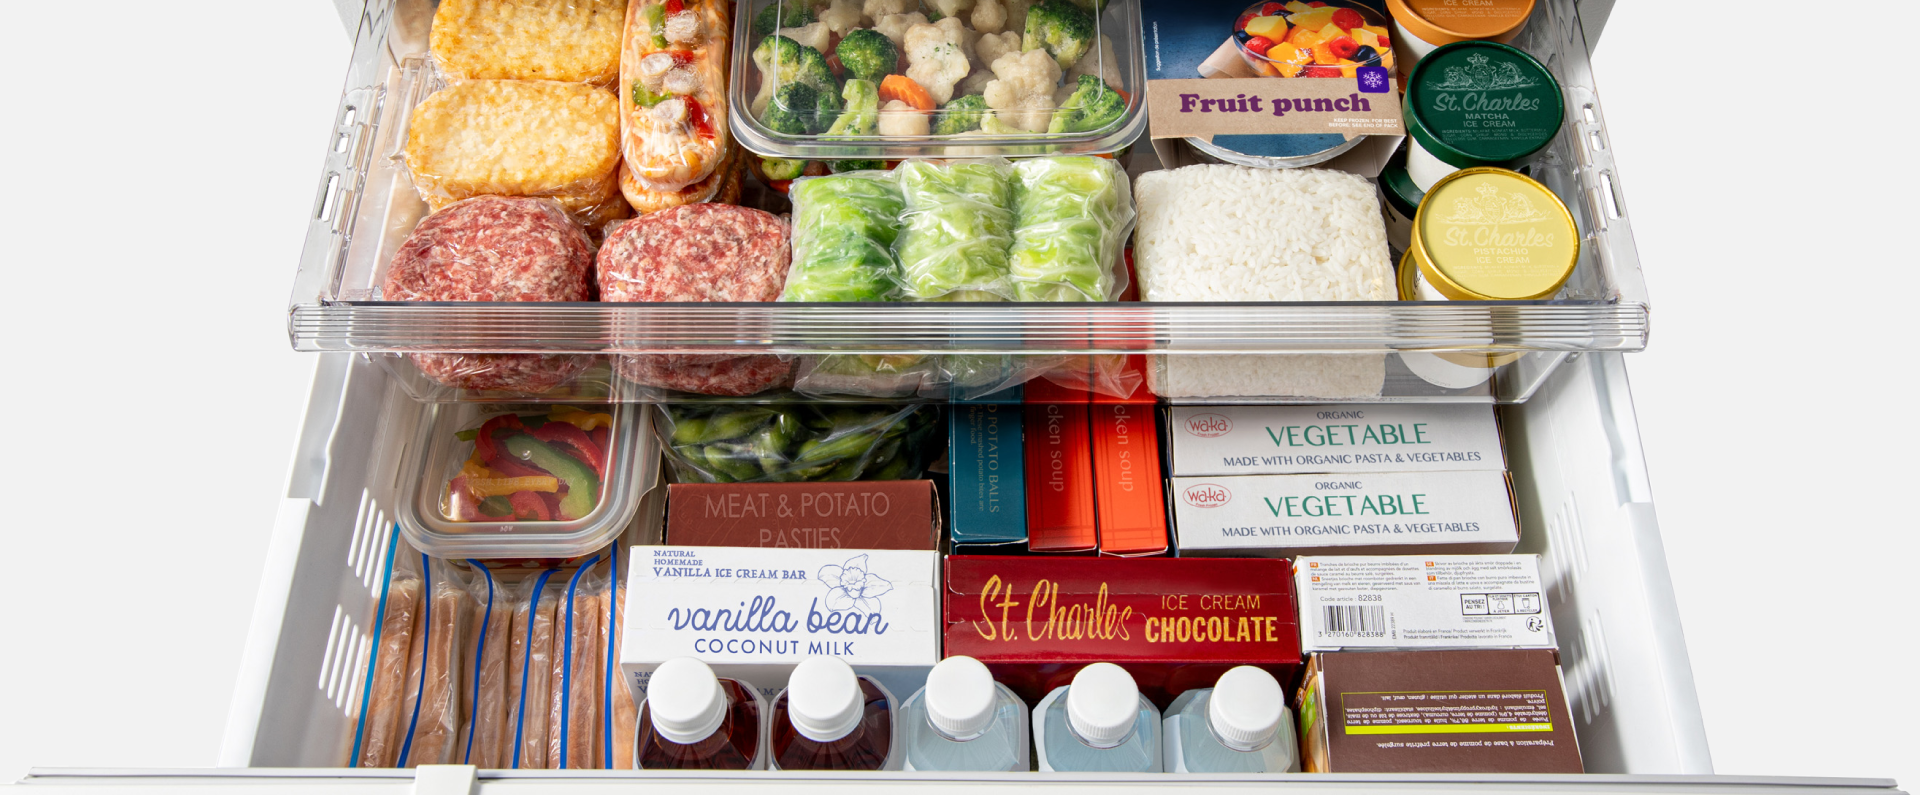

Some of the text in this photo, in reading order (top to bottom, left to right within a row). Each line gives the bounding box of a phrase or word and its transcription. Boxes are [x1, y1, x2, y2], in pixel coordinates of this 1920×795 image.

[1179, 93, 1371, 116] Fruit punch
[1433, 92, 1540, 112] St. Charles
[1443, 226, 1554, 247] St. Charles
[1317, 411, 1364, 419] ORGANIC
[988, 417, 998, 471] POTATO
[1265, 423, 1431, 447] VEGETABLE
[1048, 405, 1064, 492] cken soup
[1114, 405, 1133, 491] cken soup
[1223, 451, 1481, 466] MADE WITH ORGANIC PASTA & VEGETABLES
[977, 460, 985, 481] potato
[989, 475, 999, 513] BALLS
[1315, 481, 1362, 490] ORGANIC
[705, 493, 769, 518] MEAT
[777, 493, 793, 518] &
[801, 492, 889, 517] POTATO
[1263, 494, 1430, 517] VEGETABLE
[759, 528, 841, 549] PASTIES
[1222, 522, 1480, 537] MADE WITH ORGANIC PASTA & VEGETABLES
[653, 567, 807, 580] VANILLA ICE CREAM BAR
[972, 574, 1132, 641] St. Charles
[1162, 595, 1261, 611] ICE CREAM
[667, 595, 889, 635] vanilla bean
[1145, 616, 1278, 643] CHOCOLATE
[694, 638, 855, 655] COCONUT MILK
